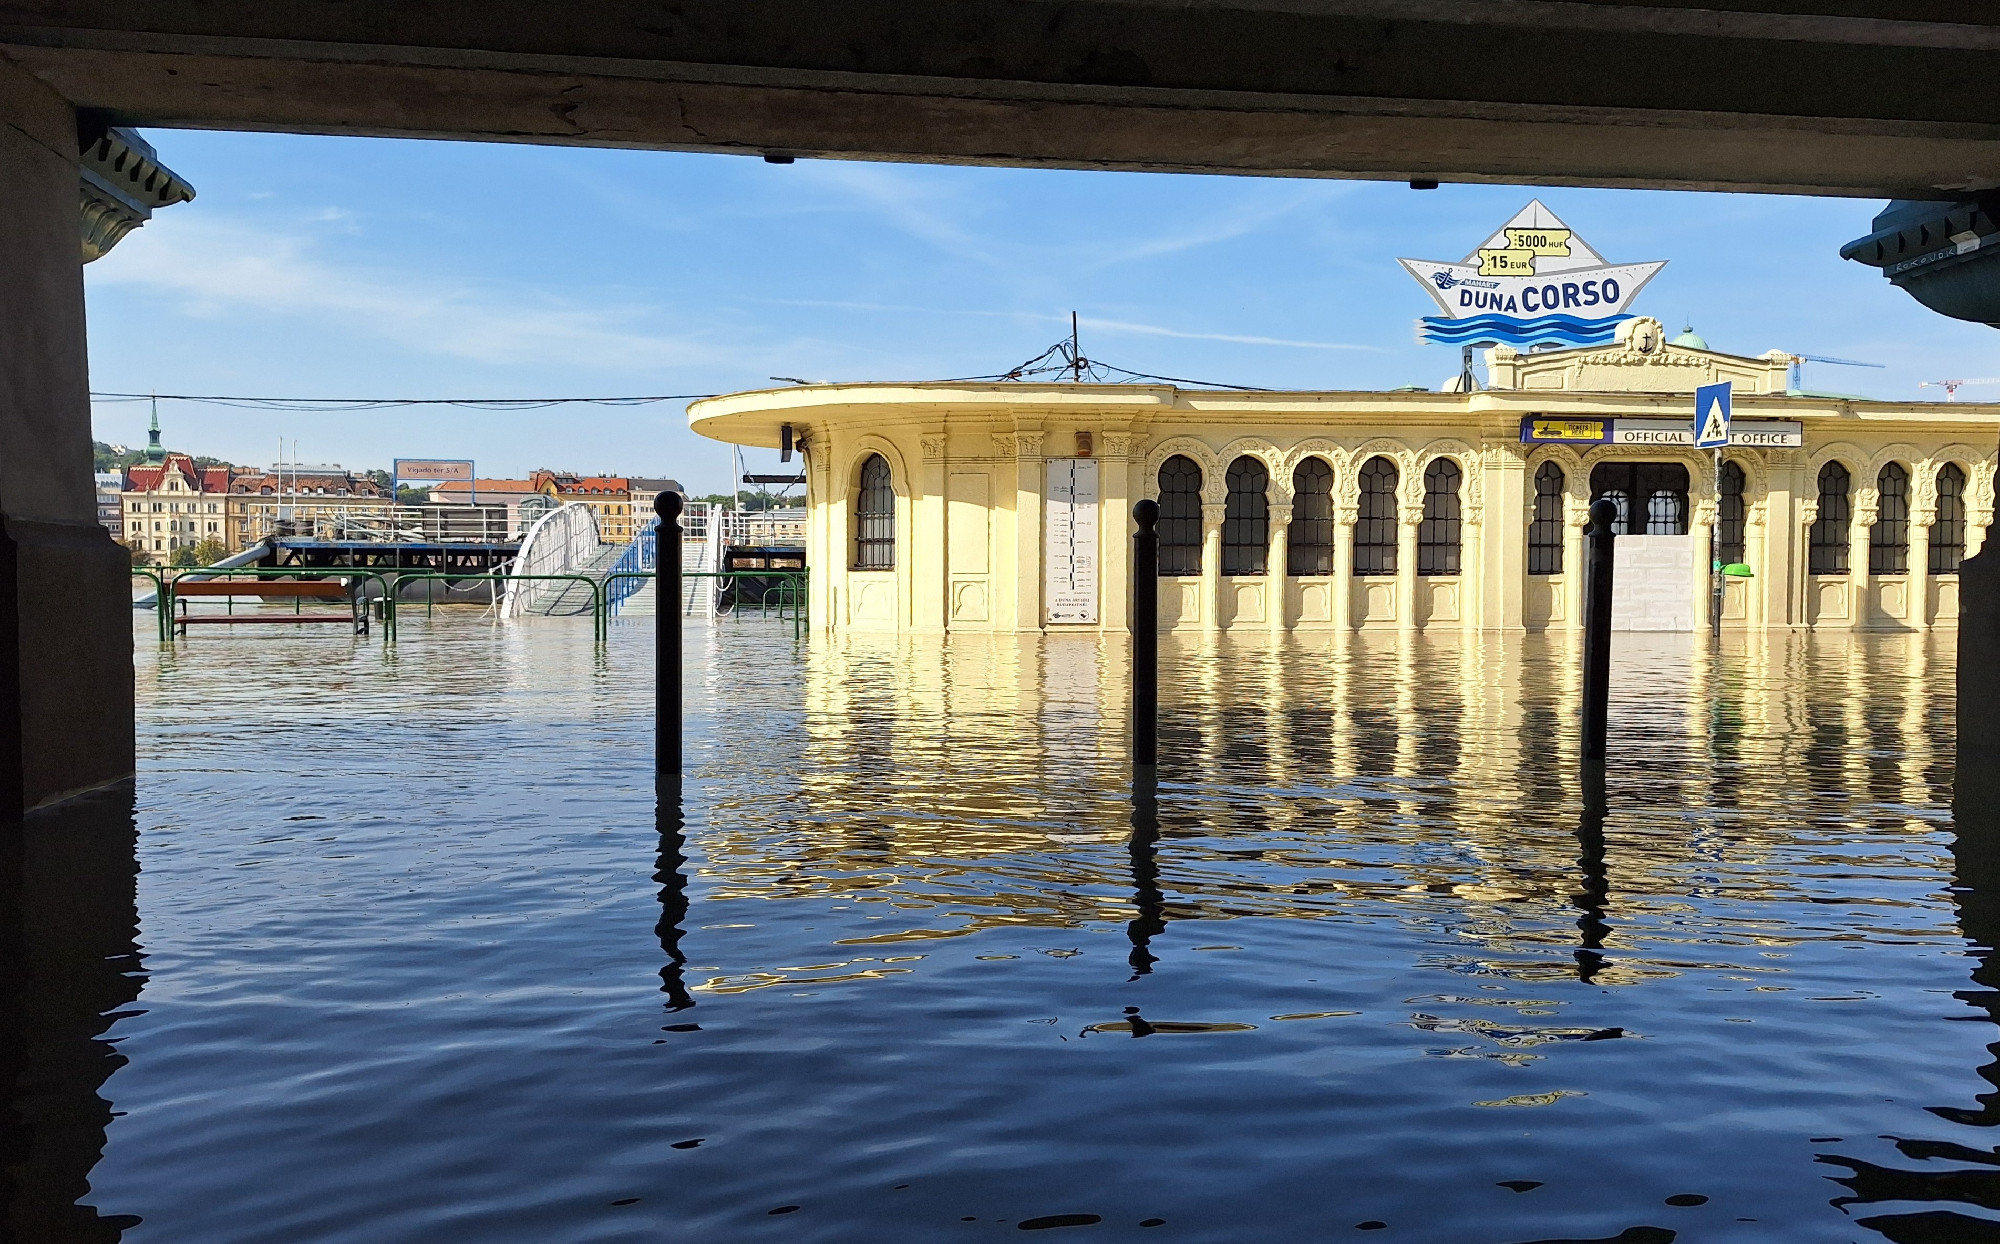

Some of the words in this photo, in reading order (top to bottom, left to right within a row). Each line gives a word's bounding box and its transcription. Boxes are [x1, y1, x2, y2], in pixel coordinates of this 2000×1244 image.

[1518, 234, 1547, 248] 5000
[1548, 241, 1564, 249] HUF
[1490, 255, 1508, 269] 15
[1510, 261, 1527, 270] EUR
[1464, 279, 1496, 289] MAHART
[1459, 288, 1518, 314] DUNA
[1521, 278, 1620, 312] CORSO
[1624, 431, 1686, 443] OFFICIAL
[1741, 433, 1788, 445] OFFICE
